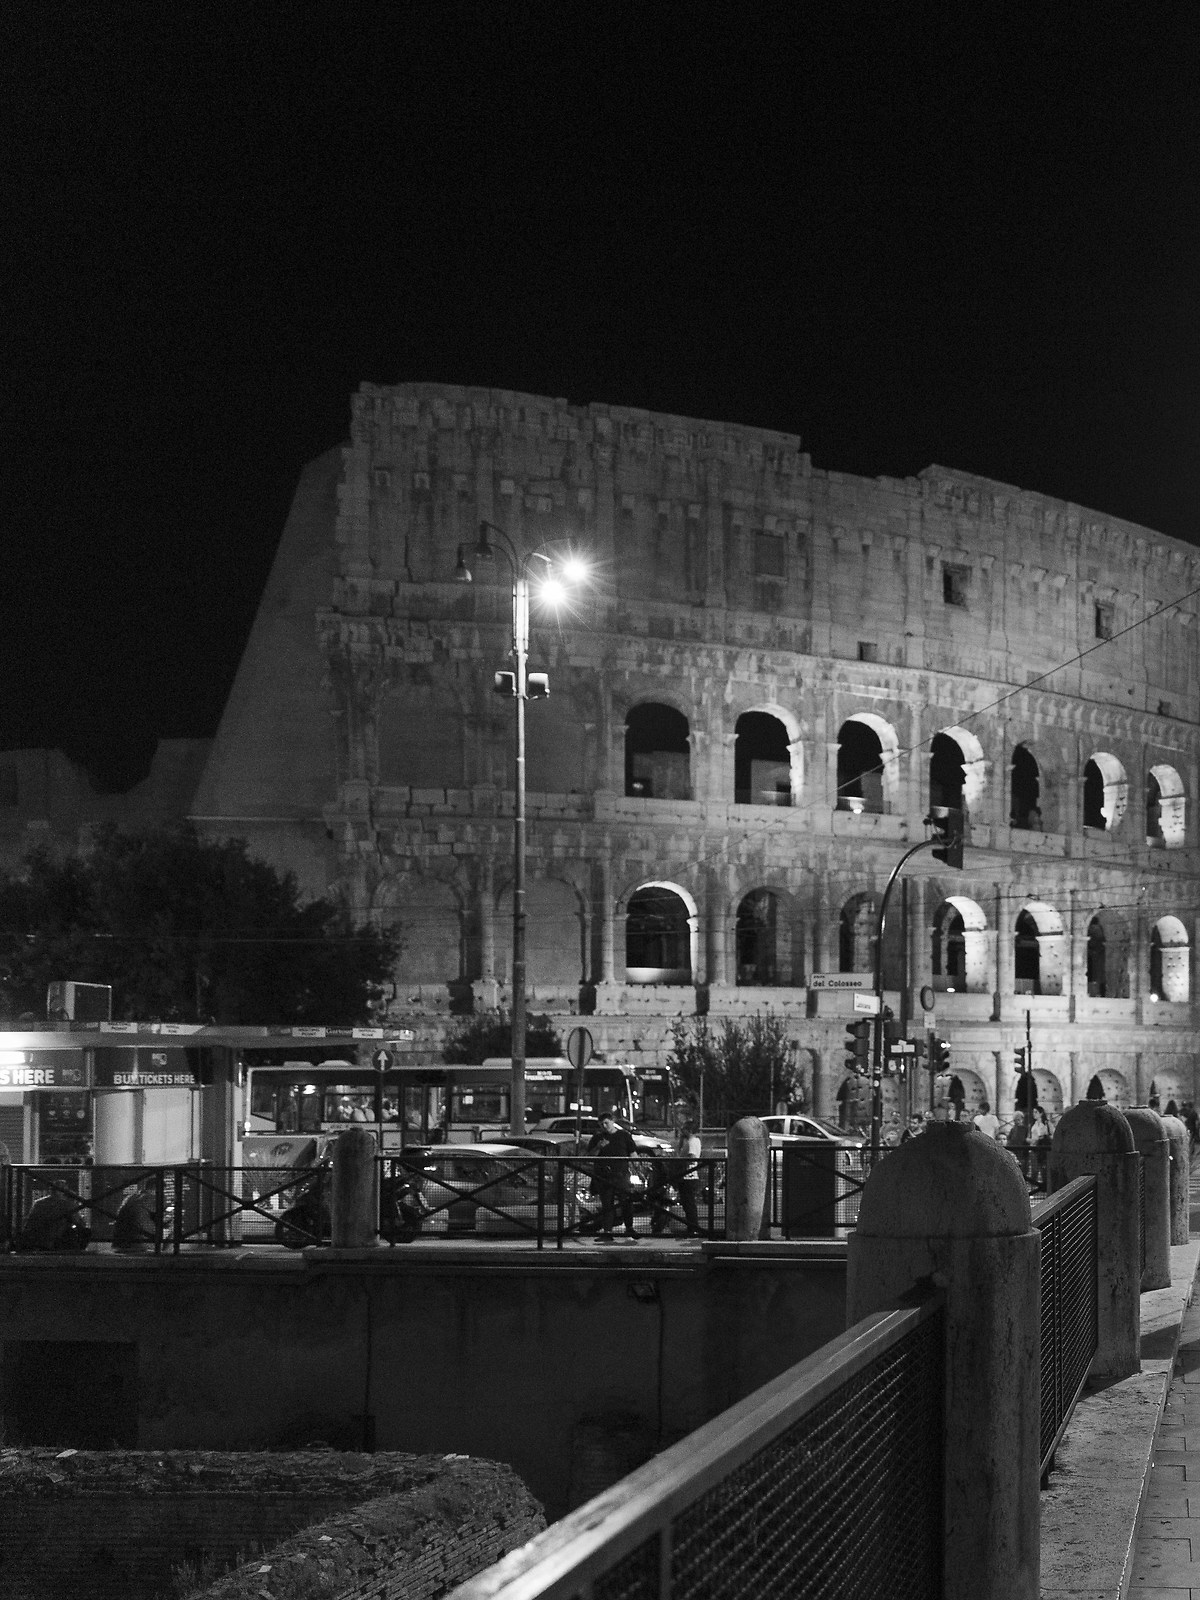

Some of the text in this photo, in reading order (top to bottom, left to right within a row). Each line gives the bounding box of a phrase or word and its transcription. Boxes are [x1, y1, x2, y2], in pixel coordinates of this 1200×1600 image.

[12, 1069, 55, 1085] HERE
[139, 1074, 173, 1084] TICKETS
[173, 1074, 195, 1084] HERE
